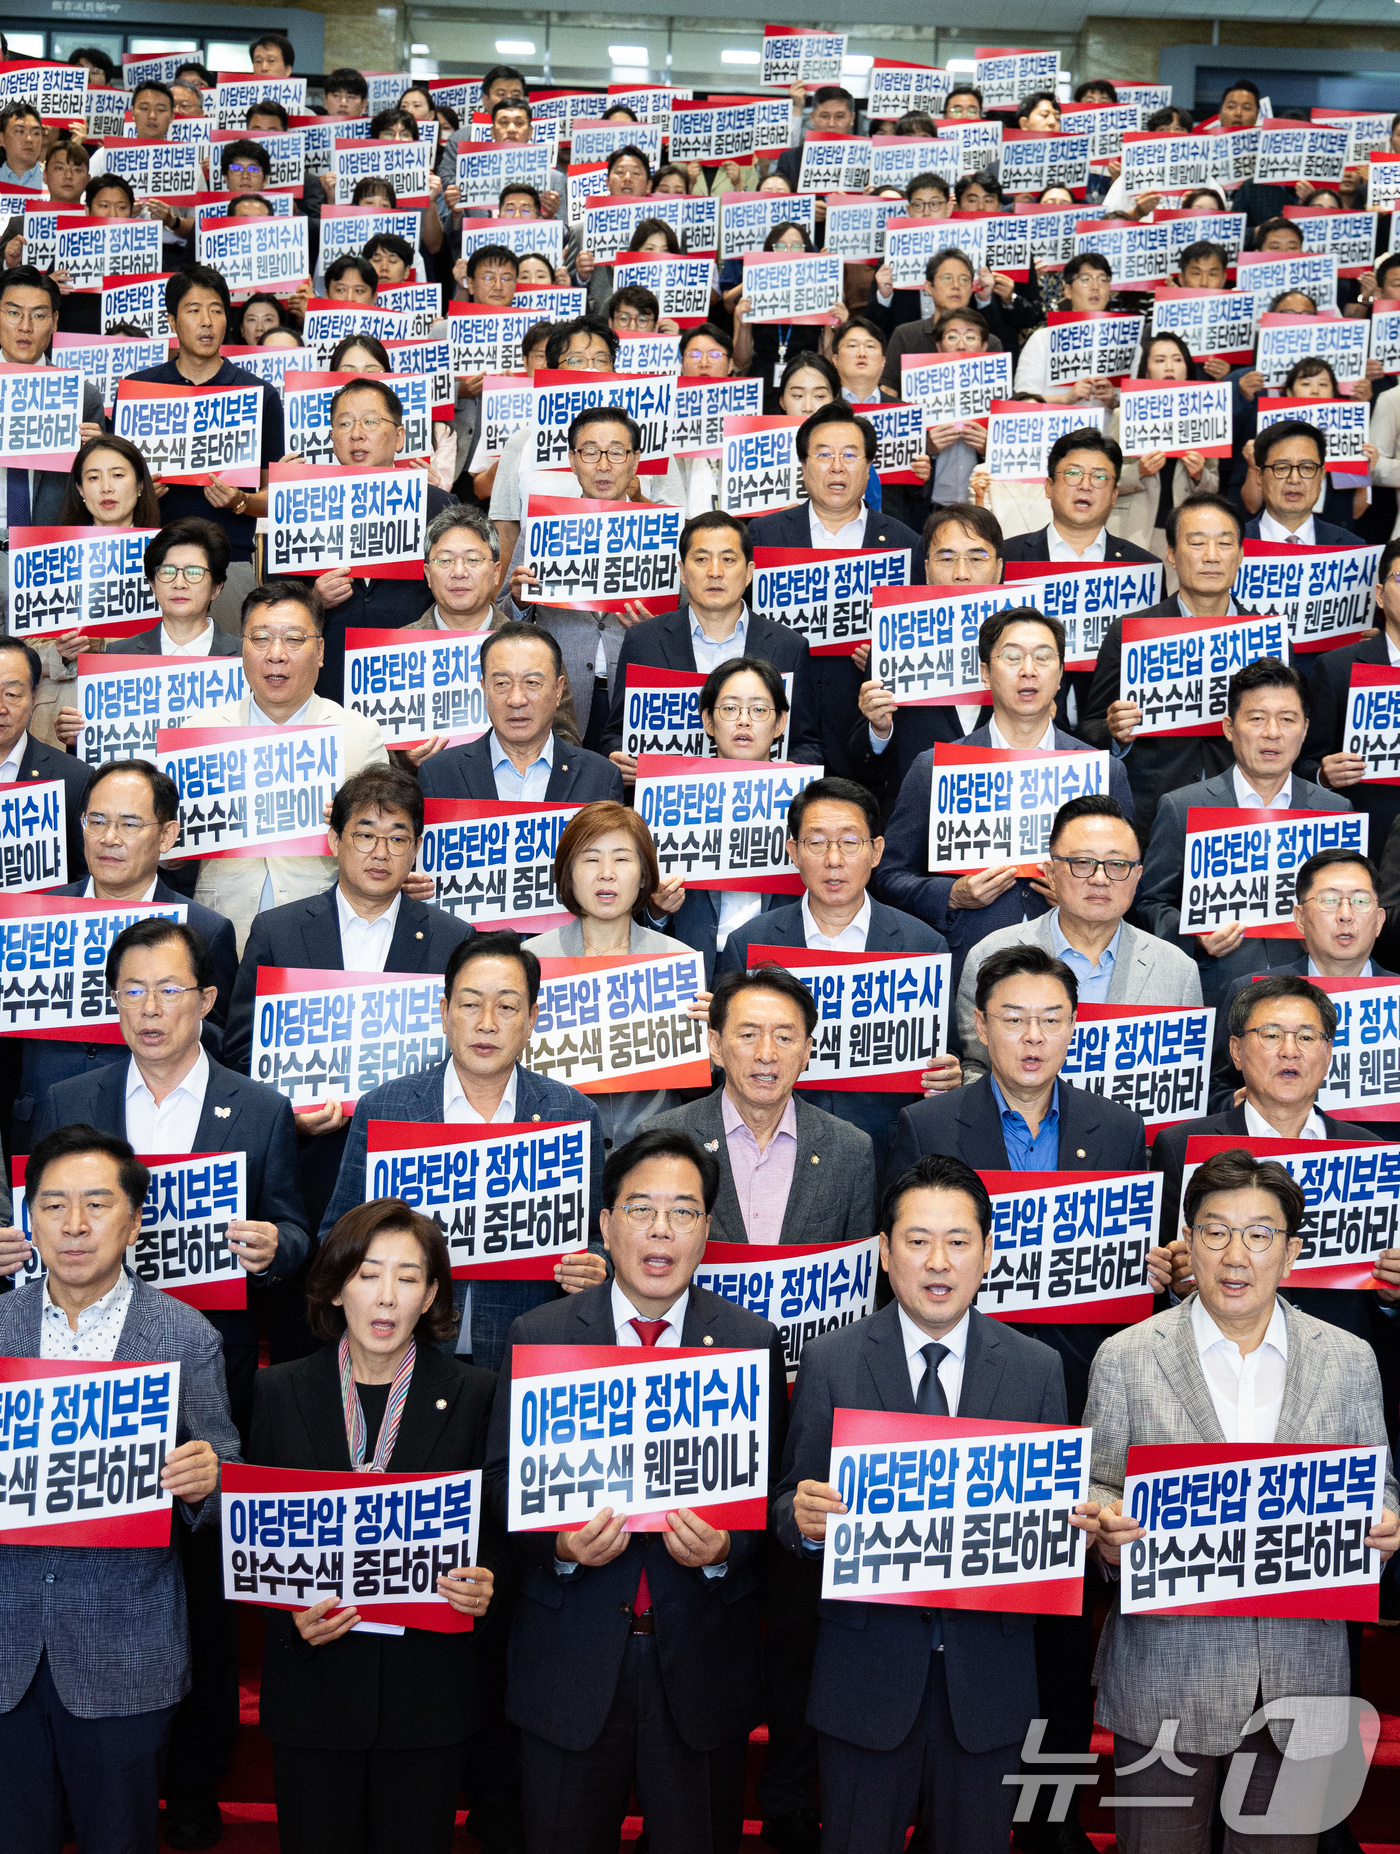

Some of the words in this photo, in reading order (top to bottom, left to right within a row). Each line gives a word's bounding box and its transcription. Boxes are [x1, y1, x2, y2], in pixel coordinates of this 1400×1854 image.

[765, 39, 802, 59] 야당탄압
[805, 37, 843, 57] 정치보복
[40, 69, 85, 91] 정치보복
[765, 62, 799, 81] 압수수색
[874, 72, 913, 93] 야당탄압
[915, 73, 951, 93] 정치수사
[977, 60, 1017, 82] 야당탄압
[1019, 55, 1058, 78] 정치보복
[40, 93, 83, 116] 중단하라
[219, 86, 259, 107] 야당탄압
[570, 97, 607, 116] 정치보복
[672, 107, 713, 134] 야당탄압
[716, 105, 755, 131] 정치보복
[1099, 108, 1138, 131] 정치보복
[672, 135, 711, 158] 압수수색
[714, 131, 754, 154] 중단하라
[963, 128, 998, 148] 정치수사
[1003, 143, 1045, 166] 야당탄압
[1047, 139, 1088, 160] 정치보복
[1125, 144, 1167, 167] 야당탄압
[1170, 142, 1210, 164] 정치수사
[1262, 130, 1306, 154] 야당탄압
[1308, 132, 1349, 154] 정치보복
[105, 150, 149, 173] 야당탄압
[152, 146, 195, 169] 정치보복
[339, 154, 380, 176] 야당탄압
[384, 147, 426, 170] 정치수사
[460, 155, 501, 178] 야당탄압
[505, 149, 548, 172] 정치보복
[806, 146, 846, 166] 야당탄압
[874, 149, 915, 171] 야당탄압
[918, 145, 960, 168] 정치수사
[1259, 156, 1300, 178] 압수수색
[151, 171, 195, 192] 중단하라
[803, 168, 841, 188] 압수수색
[1002, 168, 1043, 190] 압수수색
[1124, 170, 1165, 190] 압수수색
[588, 211, 632, 234] 야당탄압
[724, 203, 767, 226] 야당탄압
[770, 199, 811, 221] 정치보복
[829, 209, 873, 231] 야당탄압
[1201, 218, 1241, 239] 정치보복
[59, 232, 107, 258] 야당탄압
[109, 225, 158, 252] 정치보복
[206, 233, 252, 259] 야당탄압
[256, 223, 303, 252] 정치수사
[323, 217, 369, 244] 야당탄압
[514, 226, 558, 247] 정치수사
[829, 232, 871, 254] 압수수색
[889, 232, 936, 255] 야당탄압
[986, 220, 1027, 243] 정치보복
[1127, 230, 1168, 253] 정치보복
[257, 253, 304, 279] 웬말이냐
[666, 262, 710, 287] 정치보복
[746, 267, 792, 292] 야당탄압
[795, 260, 839, 285] 정치보복
[1125, 253, 1168, 277] 중단하라
[1240, 268, 1287, 291] 야당탄압
[1289, 258, 1334, 283] 정치보복
[105, 287, 154, 315] 야당탄압
[391, 287, 437, 312] 정치보복
[664, 289, 707, 313] 중단하라
[1157, 303, 1204, 328] 야당탄압
[1208, 295, 1254, 321] 정치보복
[451, 317, 499, 343] 야당탄압
[1049, 323, 1094, 353] 야당탄압
[1098, 320, 1140, 345] 정치보복
[1207, 322, 1252, 349] 중단하라
[1262, 328, 1313, 354] 야당탄압
[1315, 324, 1364, 350] 정치보복
[398, 344, 450, 374] 정치보복
[1050, 352, 1093, 380] 압수수색
[12, 375, 79, 412] 정치보복
[905, 371, 955, 400] 야당탄압
[959, 358, 1007, 388] 정치보복
[121, 403, 189, 436] 야당탄압
[194, 392, 257, 432] 정치보복
[707, 382, 759, 413] 정치보복
[1125, 393, 1173, 421] 야당탄압
[1178, 382, 1227, 412] 정치수사
[8, 413, 76, 449] 중단하라
[993, 418, 1042, 444] 야당탄압
[1125, 423, 1174, 450] 압수수색
[1178, 417, 1228, 444] 웬말이냐
[191, 430, 257, 468] 중단하라
[727, 432, 792, 472] 야당탄압
[991, 447, 1041, 472] 압수수색
[274, 485, 346, 524] 야당탄압
[351, 478, 421, 518] 정치수사
[727, 470, 790, 510] 압수수색
[274, 524, 344, 565] 압수수색
[349, 519, 420, 558] 웬말이냐
[530, 519, 603, 558] 야당탄압
[606, 513, 679, 552] 정치보복
[14, 545, 84, 588] 야당탄압
[604, 554, 677, 594] 중단하라
[1308, 553, 1377, 594] 정치수사
[757, 566, 831, 608] 야당탄압
[1084, 571, 1155, 610] 정치수사
[14, 583, 82, 630] 압수수색
[1304, 591, 1371, 634] 웬말이냐
[879, 607, 955, 652] 야당탄압
[351, 649, 426, 695] 야당탄압
[1127, 635, 1204, 684] 야당탄압
[85, 675, 162, 721] 야당탄압
[168, 667, 244, 712] 정치수사
[253, 737, 338, 788] 정치수사
[641, 781, 725, 827] 야당탄압
[937, 770, 1013, 814] 야당탄압
[422, 822, 509, 872] 야당탄압
[937, 817, 1012, 860] 압수수색
[1190, 831, 1271, 880] 야당탄압
[1188, 877, 1268, 926] 압수수색
[606, 960, 698, 1019] 정치보복
[851, 963, 943, 1020] 정치수사
[260, 992, 353, 1049] 야당탄압
[609, 1014, 702, 1068] 중단하라
[850, 1017, 941, 1068] 웬말이냐
[1116, 1014, 1208, 1069] 정치보복
[374, 1152, 480, 1206] 야당탄압
[486, 1130, 584, 1198] 정치보복
[1300, 1151, 1400, 1206] 정치보복
[484, 1189, 584, 1254] 중단하라
[1053, 1180, 1154, 1244] 정치보복
[780, 1250, 872, 1318] 정치수사
[52, 1370, 169, 1445] 정치보복
[521, 1376, 636, 1447] 야당탄압
[645, 1363, 760, 1433] 정치수사
[520, 1443, 634, 1516] 압수수색
[644, 1430, 760, 1500] 웬말이냐
[839, 1448, 959, 1515] 야당탄압
[967, 1437, 1082, 1508] 정치보복
[1131, 1468, 1250, 1531] 야당탄압
[1257, 1454, 1377, 1521] 정치보복
[230, 1496, 346, 1548] 야당탄압
[354, 1480, 471, 1542] 정치보복
[832, 1516, 955, 1586] 압수수색
[1130, 1528, 1247, 1600] 압수수색
[232, 1549, 343, 1600] 압수수색
